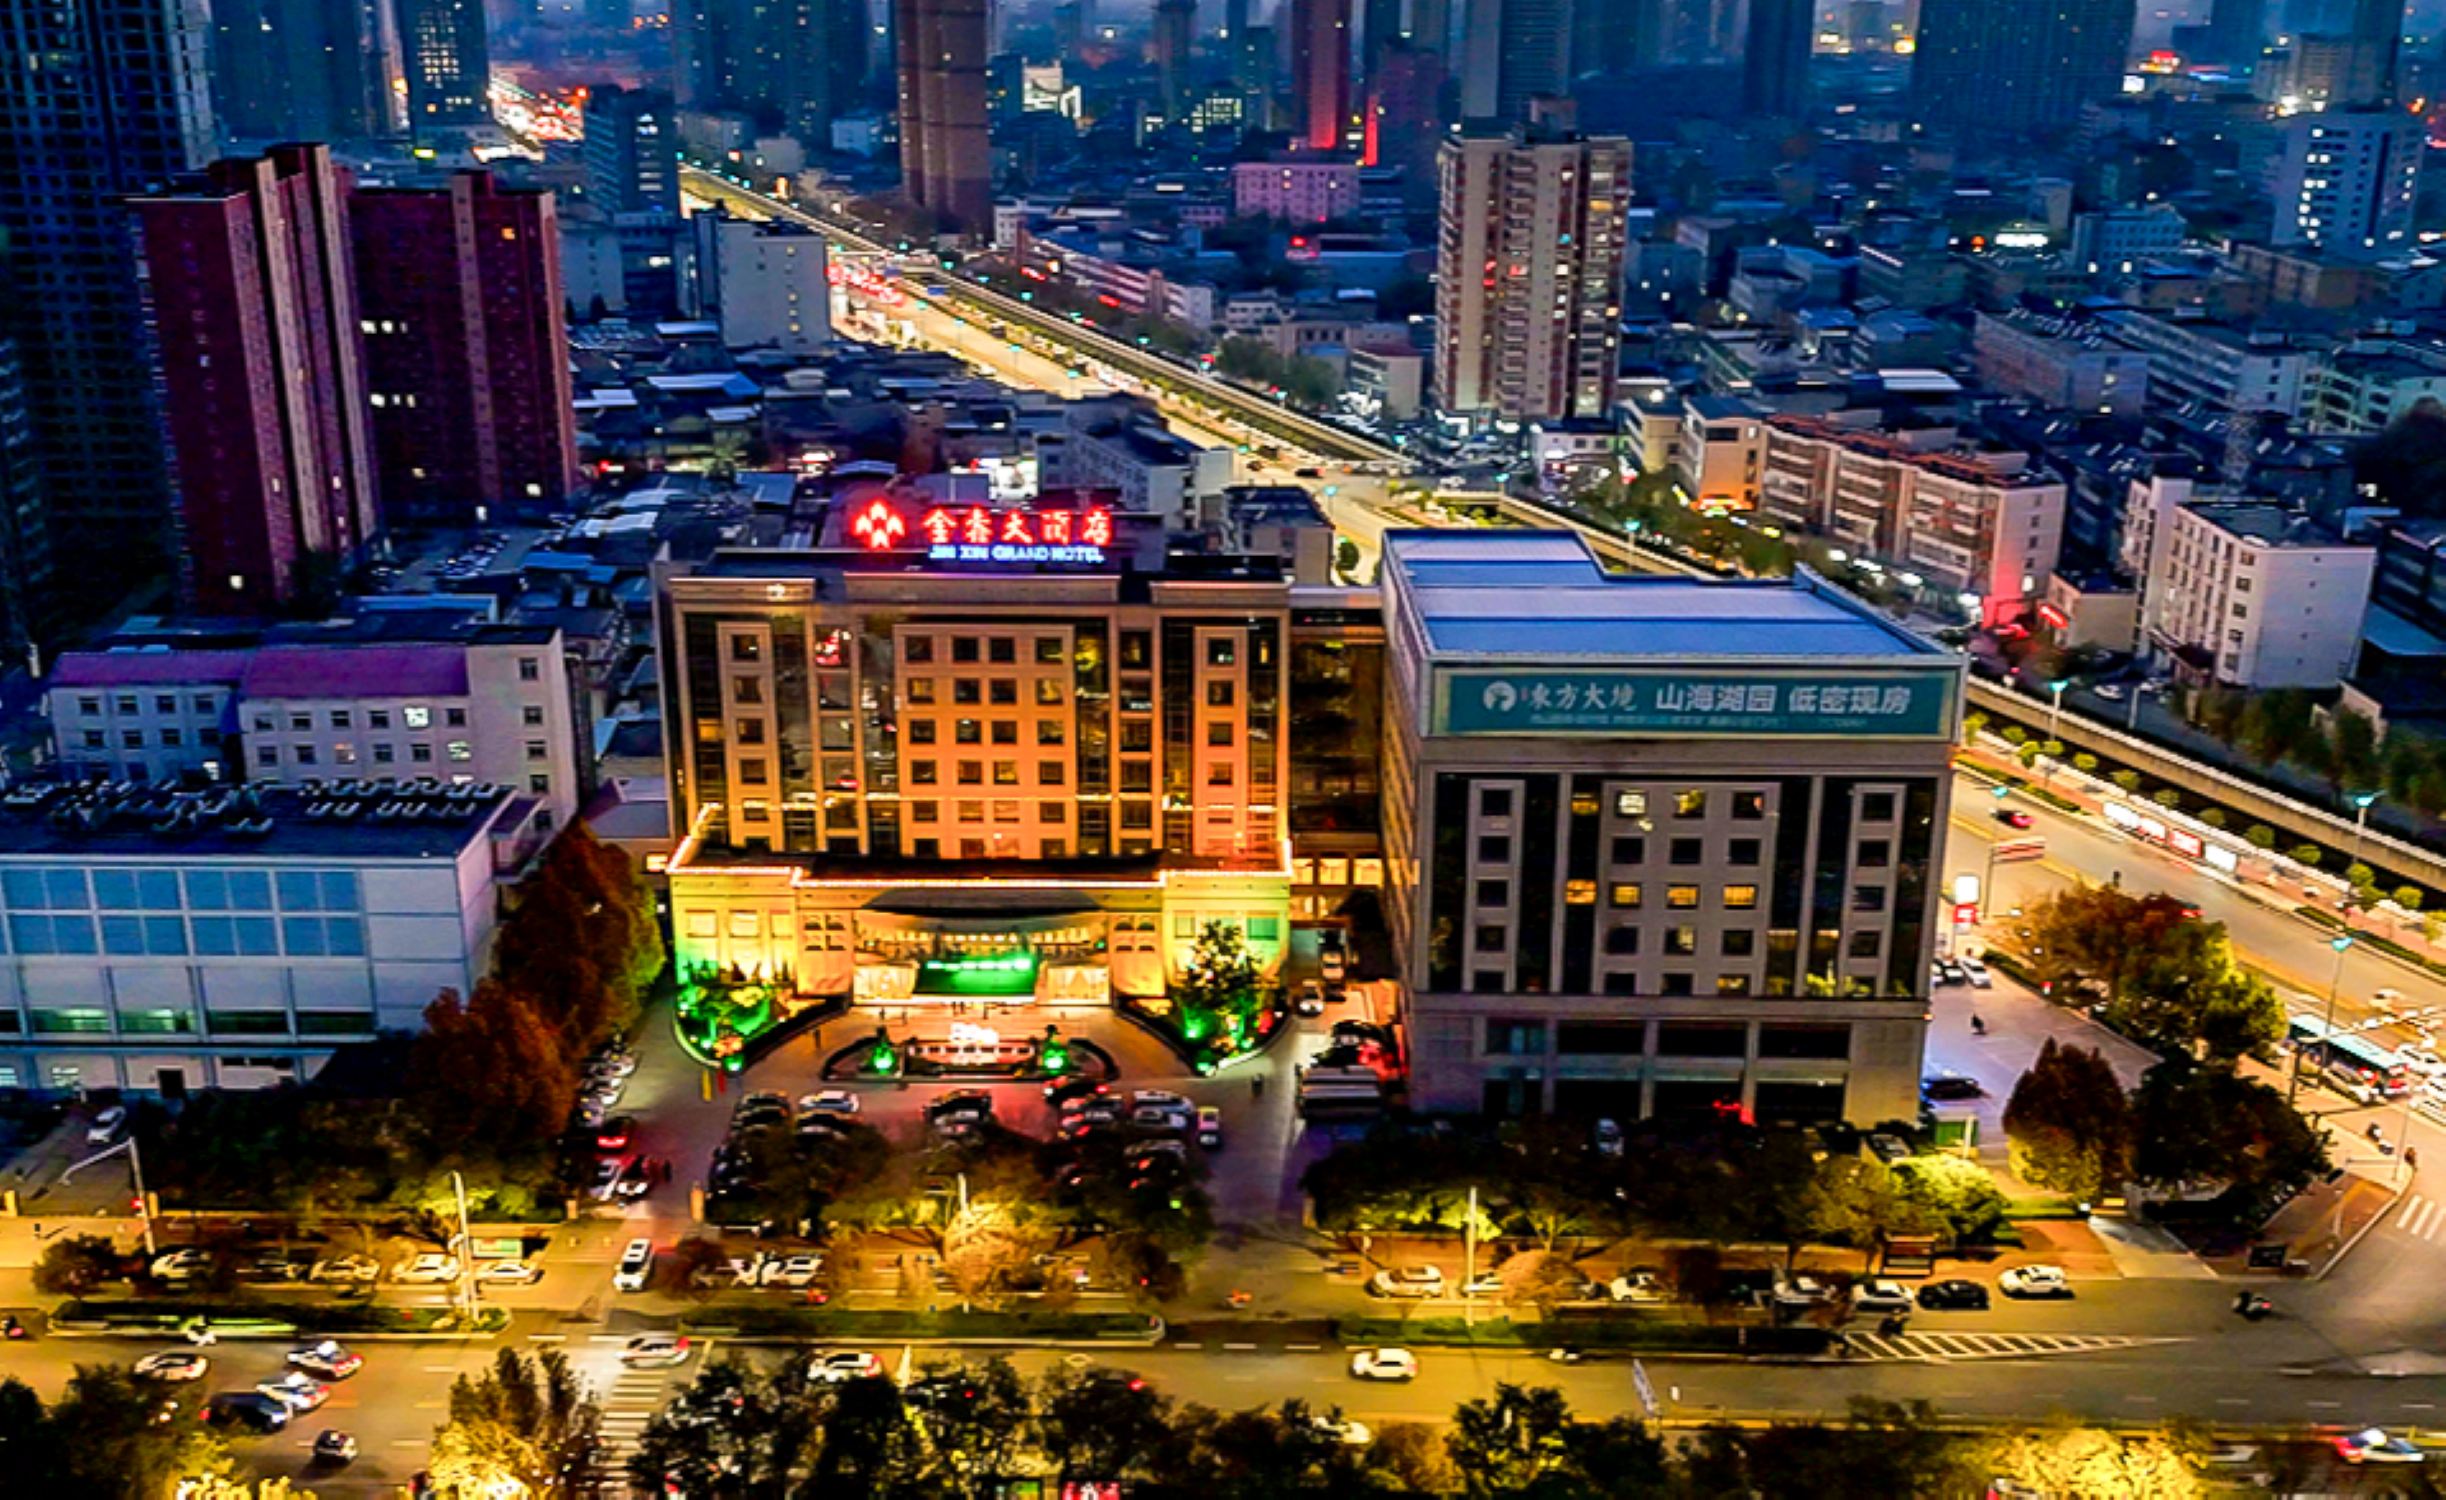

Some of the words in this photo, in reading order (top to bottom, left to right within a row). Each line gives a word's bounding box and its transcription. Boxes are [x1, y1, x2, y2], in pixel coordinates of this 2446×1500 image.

[929, 545, 956, 559] JIN
[959, 545, 989, 560] XIN
[991, 544, 1048, 561] GRAND
[1050, 546, 1105, 563] HOTEL
[1656, 682, 1778, 712] 山海湖园
[1789, 684, 1911, 714] 低密现房
